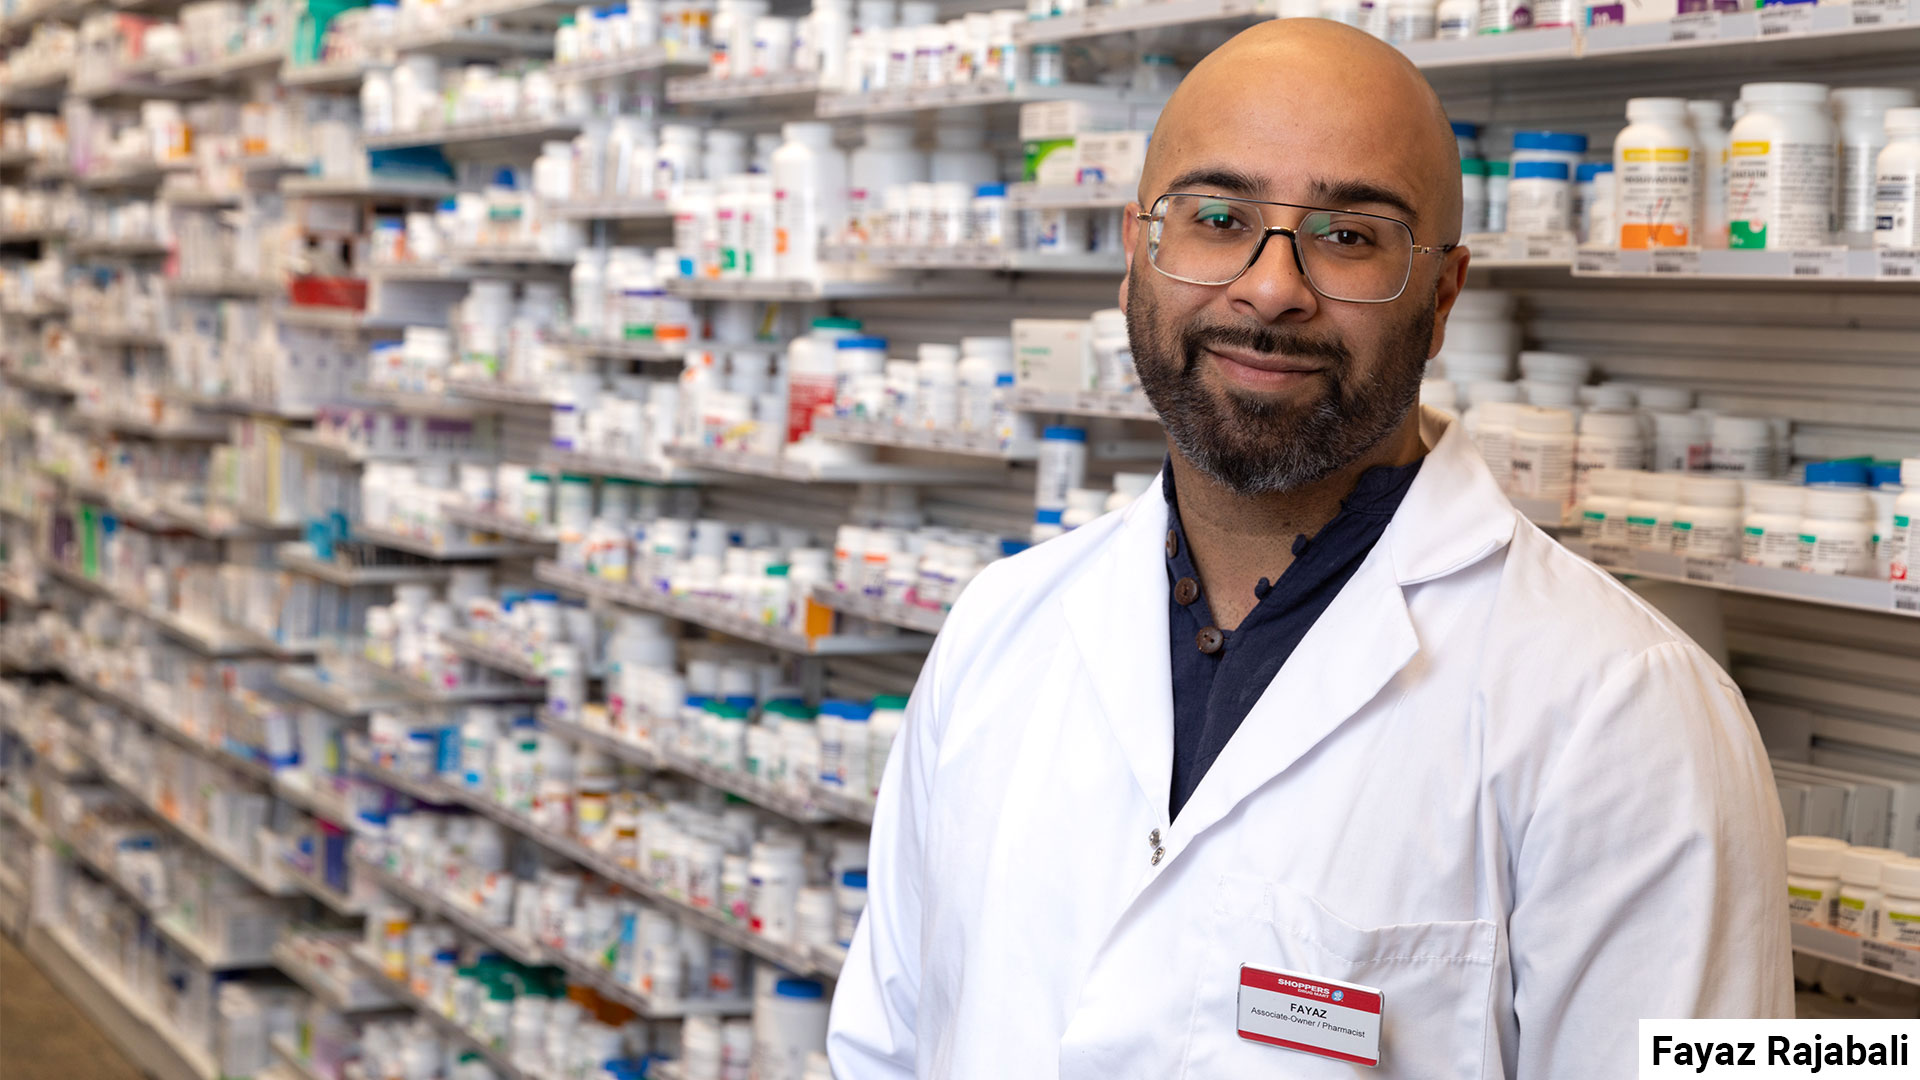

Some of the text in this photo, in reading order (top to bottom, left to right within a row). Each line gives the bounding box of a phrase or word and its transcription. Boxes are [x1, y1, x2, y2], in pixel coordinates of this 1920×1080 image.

[1278, 978, 1330, 994] SHOPPERS
[1290, 1003, 1327, 1019] FAYAZ
[1251, 1007, 1316, 1027] Associate-Owner
[1322, 1022, 1365, 1038] Pharmacist
